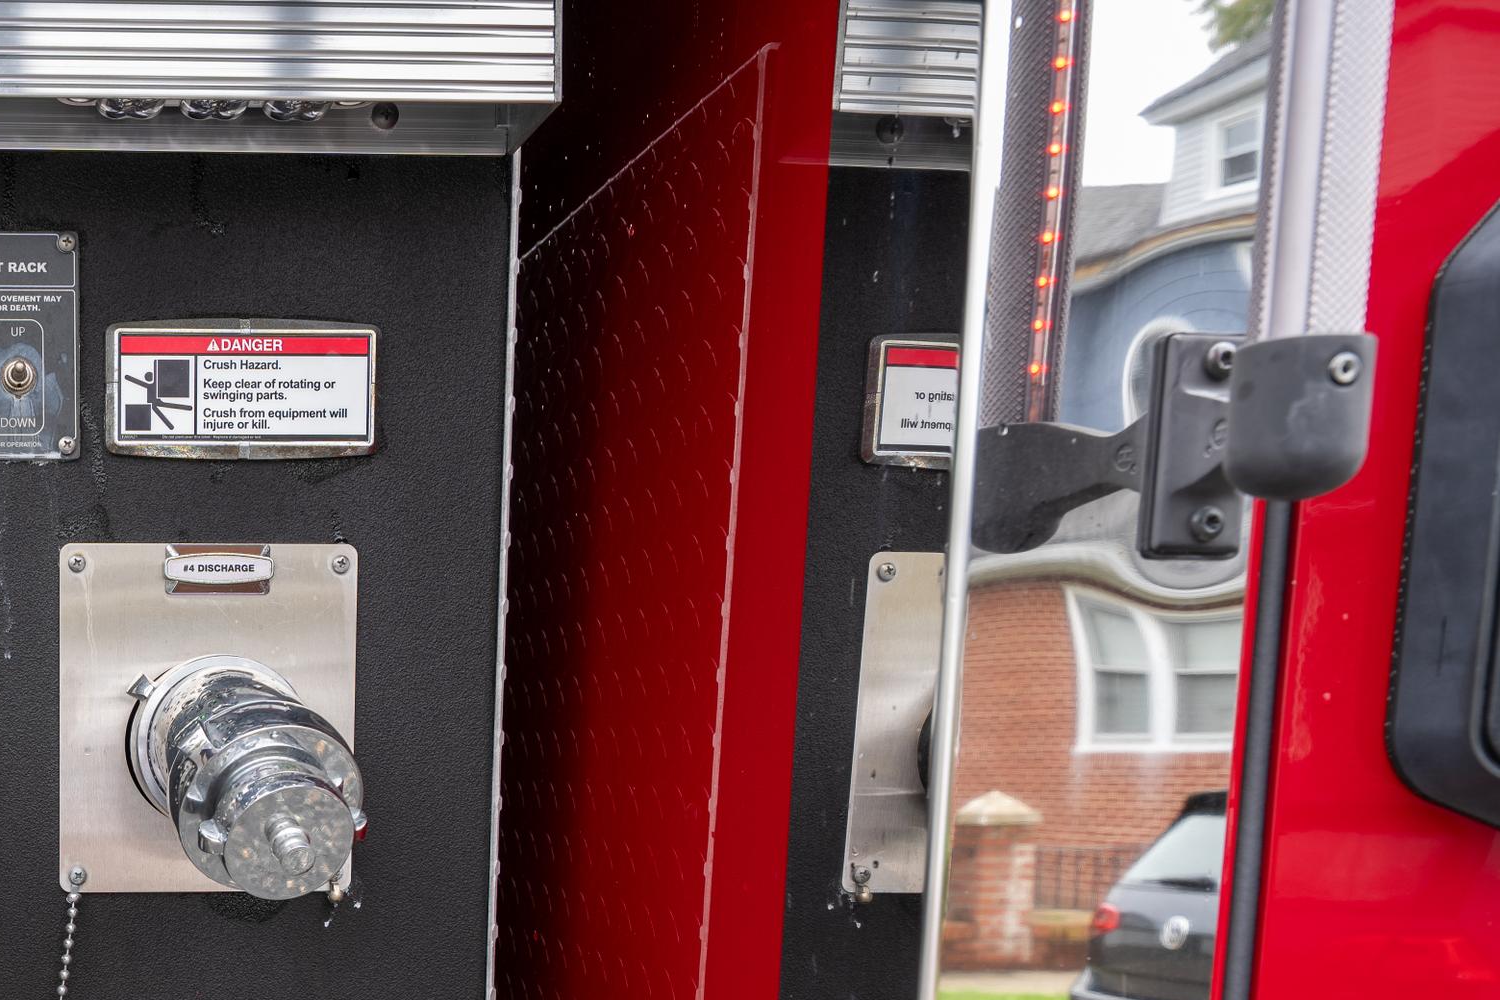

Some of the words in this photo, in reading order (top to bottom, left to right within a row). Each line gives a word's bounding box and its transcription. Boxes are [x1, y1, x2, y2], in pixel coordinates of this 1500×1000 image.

[8, 262, 48, 273] RACK
[43, 295, 62, 303] MAY
[10, 304, 41, 312] DEATH.
[10, 326, 26, 337] UP
[221, 339, 283, 351] DANGER
[203, 359, 237, 370] Crush
[240, 359, 281, 370] Hazard.
[203, 378, 232, 391] Keep
[234, 378, 261, 389] clear
[264, 378, 276, 389] of
[278, 379, 321, 391] rotating
[323, 381, 336, 389] or
[203, 390, 253, 402] swinging
[256, 390, 287, 402] parts.
[203, 407, 236, 418] Crush
[239, 407, 265, 418] from
[268, 407, 326, 420] equipment
[329, 408, 348, 418] will
[0, 417, 36, 428] DOWN
[203, 420, 234, 431] injure
[237, 421, 249, 429] or
[251, 419, 270, 429] kill.
[183, 564, 195, 572] #4
[197, 564, 255, 572] DISCHARGE
